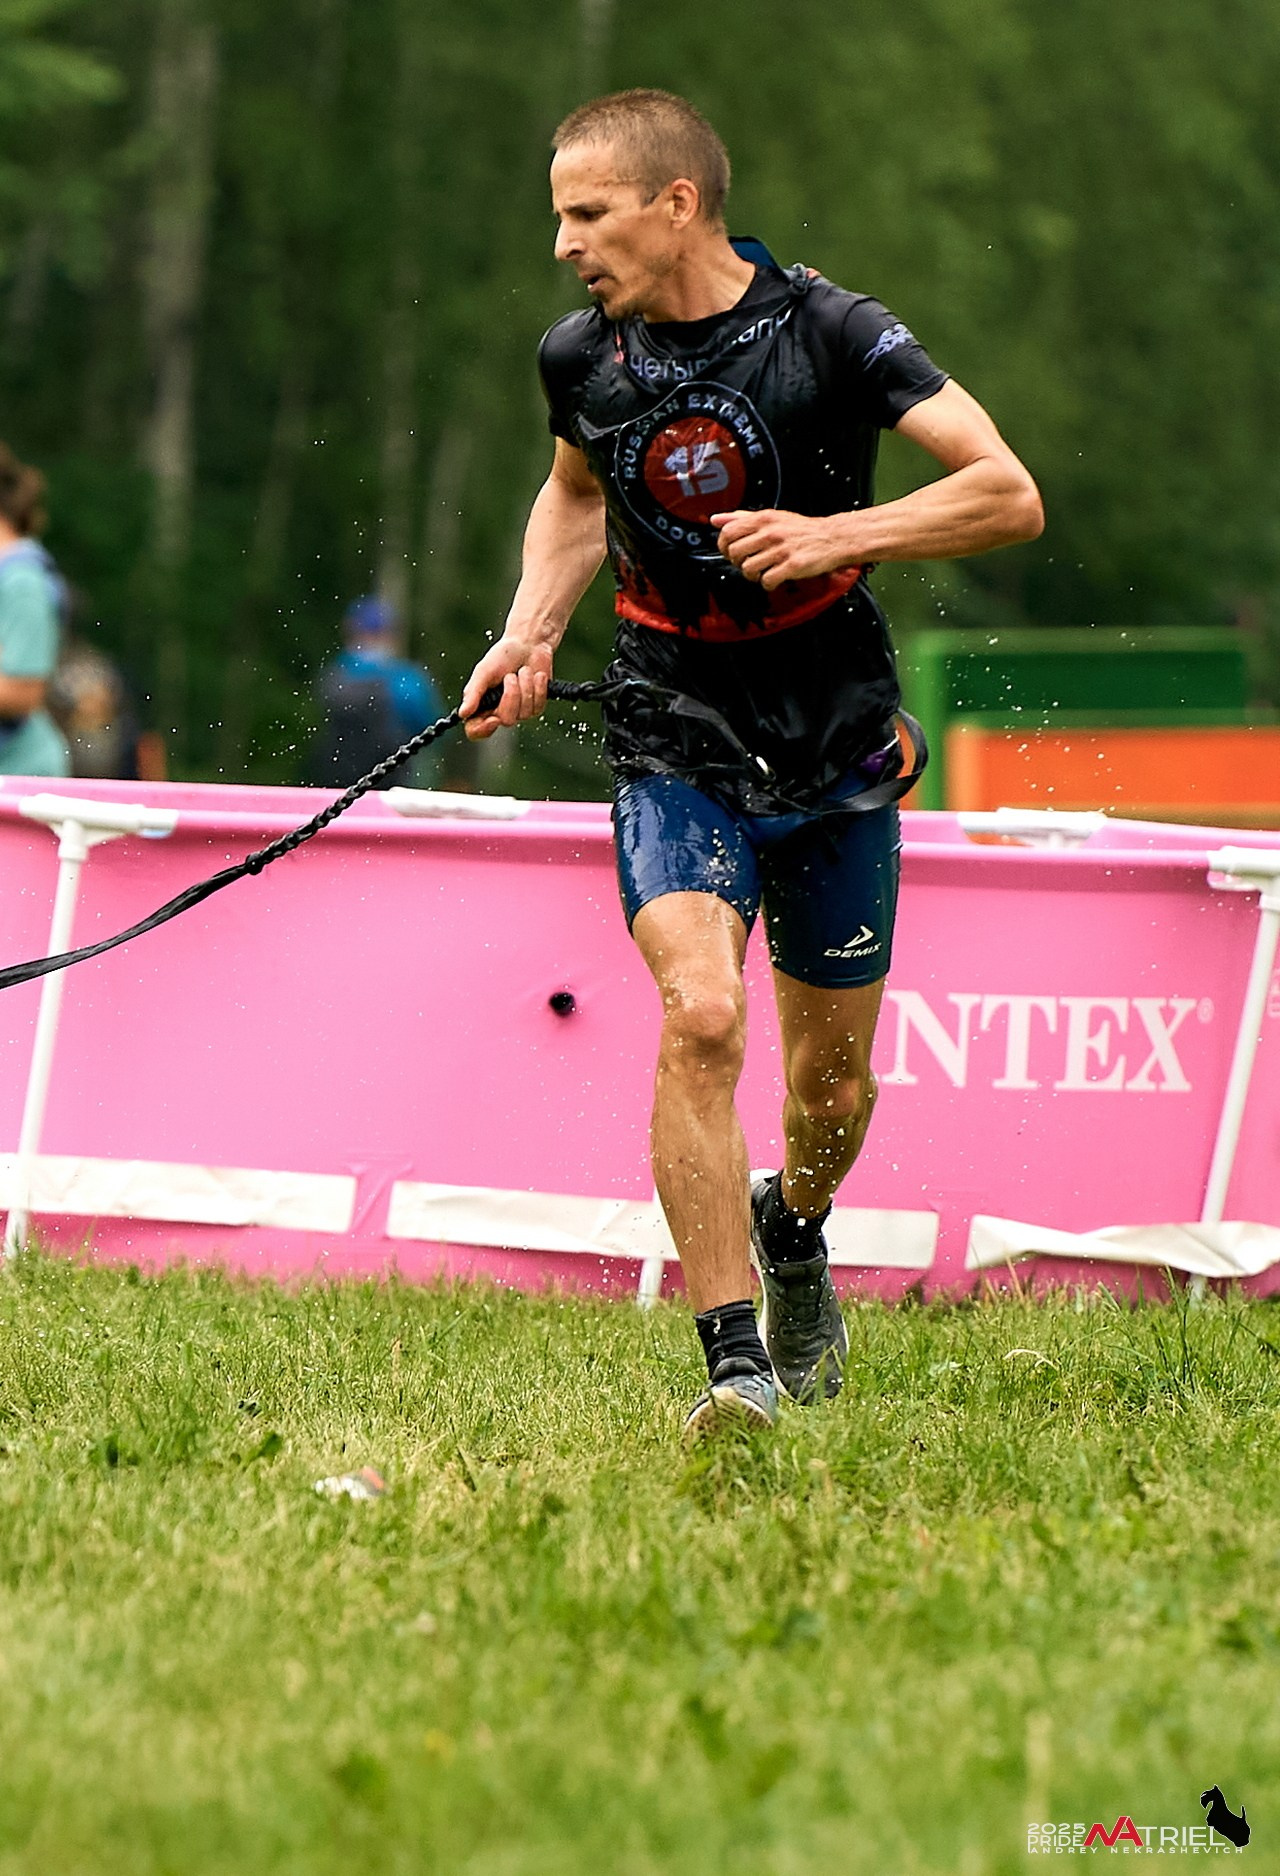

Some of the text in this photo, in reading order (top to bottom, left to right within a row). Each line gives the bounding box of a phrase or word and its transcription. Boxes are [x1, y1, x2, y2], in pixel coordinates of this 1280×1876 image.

[664, 440, 730, 497] 15
[655, 514, 702, 546] DOG
[823, 942, 882, 958] DEMIX
[880, 990, 1197, 1093] NTEX
